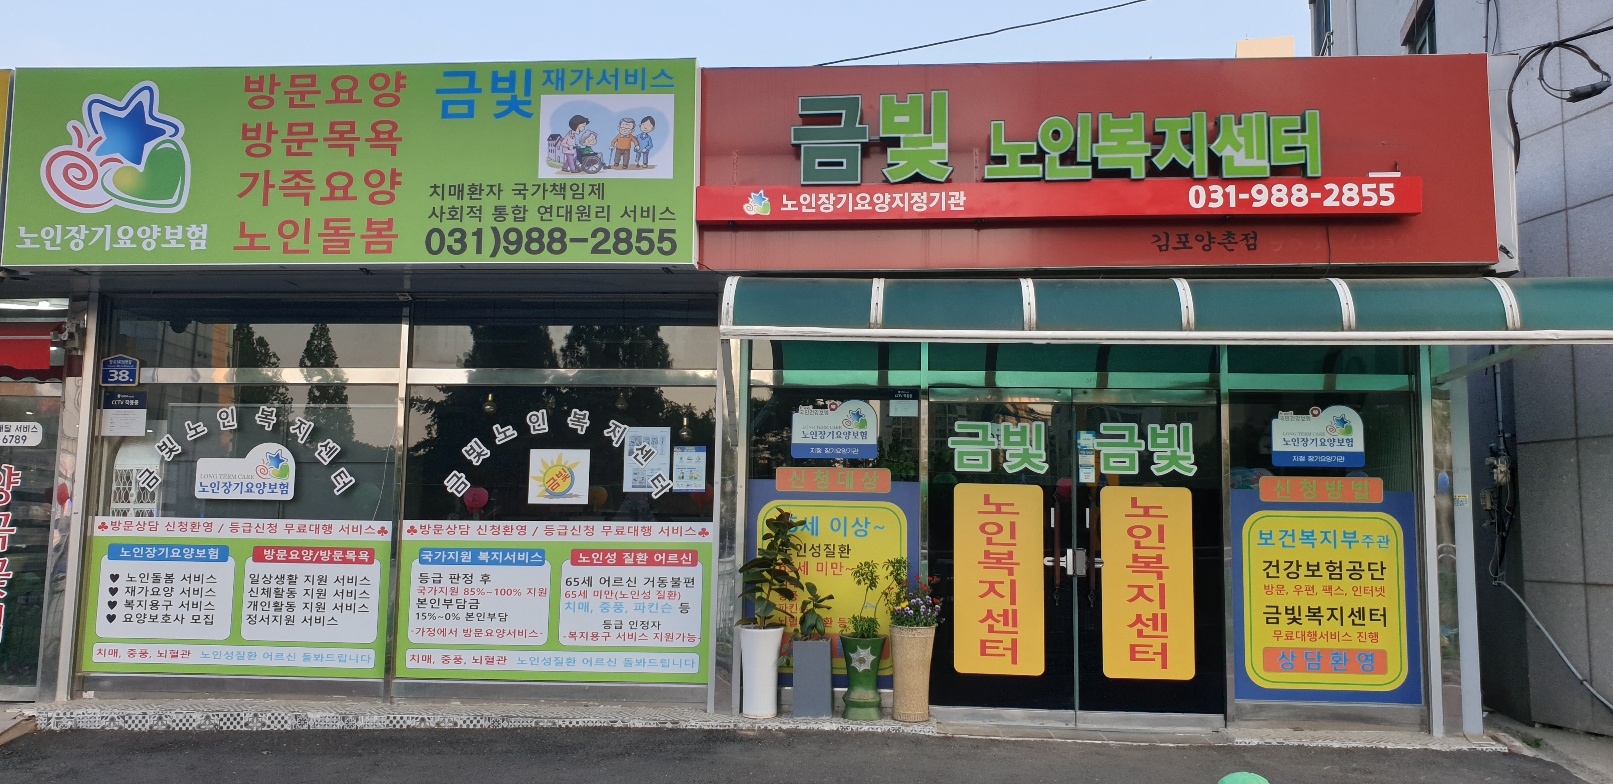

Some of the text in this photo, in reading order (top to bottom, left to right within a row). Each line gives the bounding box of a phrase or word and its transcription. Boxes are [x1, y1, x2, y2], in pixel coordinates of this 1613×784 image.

[244, 71, 407, 111] 방문요양
[435, 68, 675, 119] 금빛 재가서비스
[241, 120, 403, 158] 방문목욕
[790, 89, 954, 186] 금빛
[983, 108, 1321, 181] 노인복지센터
[237, 167, 402, 206] 가족요양
[429, 182, 605, 201] 치매환자 국가책임제
[780, 191, 966, 213] 노인장기요양지정기관
[1188, 183, 1395, 208] 031-988-2855
[428, 205, 677, 223] 사회적 통합 연대원리 서비스
[16, 224, 208, 251] 노인장기요양보험
[233, 217, 399, 255] 노인돌봄
[425, 226, 677, 257] 031)988-2855
[1151, 231, 1258, 252] 김포양촌점
[802, 431, 867, 440] 노인장기요양보험
[1283, 438, 1353, 447] 노인장기요양보험
[948, 421, 1049, 474] 금빛
[1094, 422, 1197, 476] 금빛
[546, 468, 570, 491] 금빛
[790, 470, 879, 490] 신청대상
[198, 481, 289, 495] 노인장기요양보험
[1274, 480, 1369, 500] 신청방법
[110, 520, 159, 532] 방문상담
[165, 521, 213, 533] 신청환영
[229, 522, 277, 534] 등급신청
[284, 523, 333, 535] 무료대행
[339, 523, 375, 535] 서비스
[420, 524, 470, 536] 방문상담
[476, 524, 528, 536] 신청환영
[544, 524, 594, 536] 등급신청
[601, 525, 652, 536] 무료대행
[658, 525, 697, 537] 서비스
[830, 515, 886, 538] 이상~
[120, 547, 219, 559] 노인장기요양보험
[263, 549, 370, 562] 방문요양/방문목욕
[421, 551, 543, 563] 국가지원 복지서비스
[578, 552, 692, 564] 노인성 질환 어르신
[1262, 560, 1386, 581] 건강보험공단
[126, 573, 217, 584] 노인돌봄 서비스
[249, 573, 371, 586] 일상생활 지원 서비스
[418, 573, 491, 584] 등급 판정 후
[565, 576, 695, 588] 65세 어르신 거동불편
[977, 494, 1020, 665] 노인복지센터
[1125, 497, 1169, 670] 노인복지센터
[125, 586, 216, 598] 재가요양 서비스
[248, 587, 370, 600] 신체활동 지원 서비스
[417, 586, 547, 597] 국가지원 85%~100% 지원
[565, 590, 681, 600] 65세 미만(노인성 질환)
[1263, 584, 1385, 597] 방문, 우편, 팩스, 인터넷
[124, 600, 215, 611] 복지용구 서비스
[247, 601, 369, 613] 개인활동 지원 서비스
[416, 598, 480, 609] 본인부담금
[565, 602, 690, 614] 치매, 중풍, 파킨슨 등
[779, 603, 809, 613] 파킨
[122, 613, 214, 625] 요양보호사 모집
[246, 614, 338, 626] 정서지원 서비스
[416, 612, 508, 621] 15%~0% 본인부담
[1263, 605, 1387, 627] 금빛복지센터
[602, 620, 661, 630] 등급 인정자
[616, 632, 648, 641] 서비스
[1272, 630, 1379, 643] 무료대행서비스 진행
[96, 649, 371, 663] 치매, 중풍, 뇌혈관 노인성질환 어르신 돌봐드립니다
[410, 654, 695, 668] 치매, 중풍, 뇌혈관 노인성질환 어르신 돌봐드립니다
[1277, 650, 1375, 673] 상담환영
